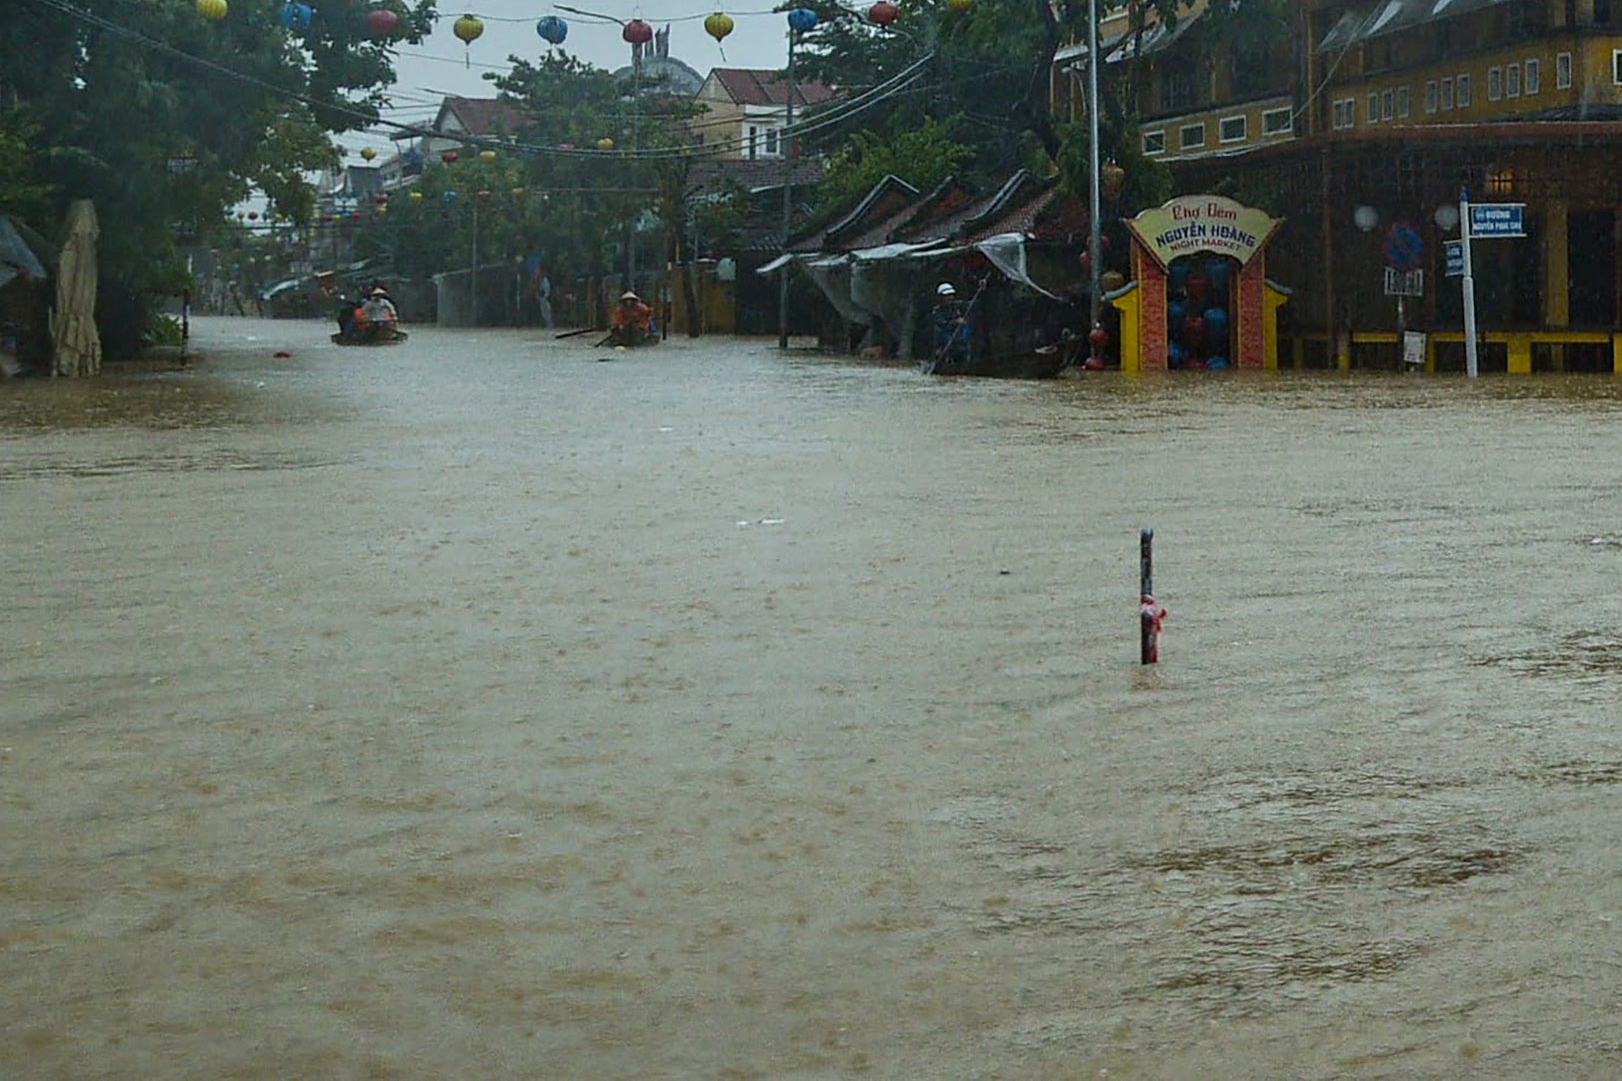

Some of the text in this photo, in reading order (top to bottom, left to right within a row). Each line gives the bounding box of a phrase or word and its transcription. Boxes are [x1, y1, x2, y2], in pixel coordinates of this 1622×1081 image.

[1170, 238, 1242, 252] NIGHT MARKET
[1211, 225, 1256, 247] HOÀNG
